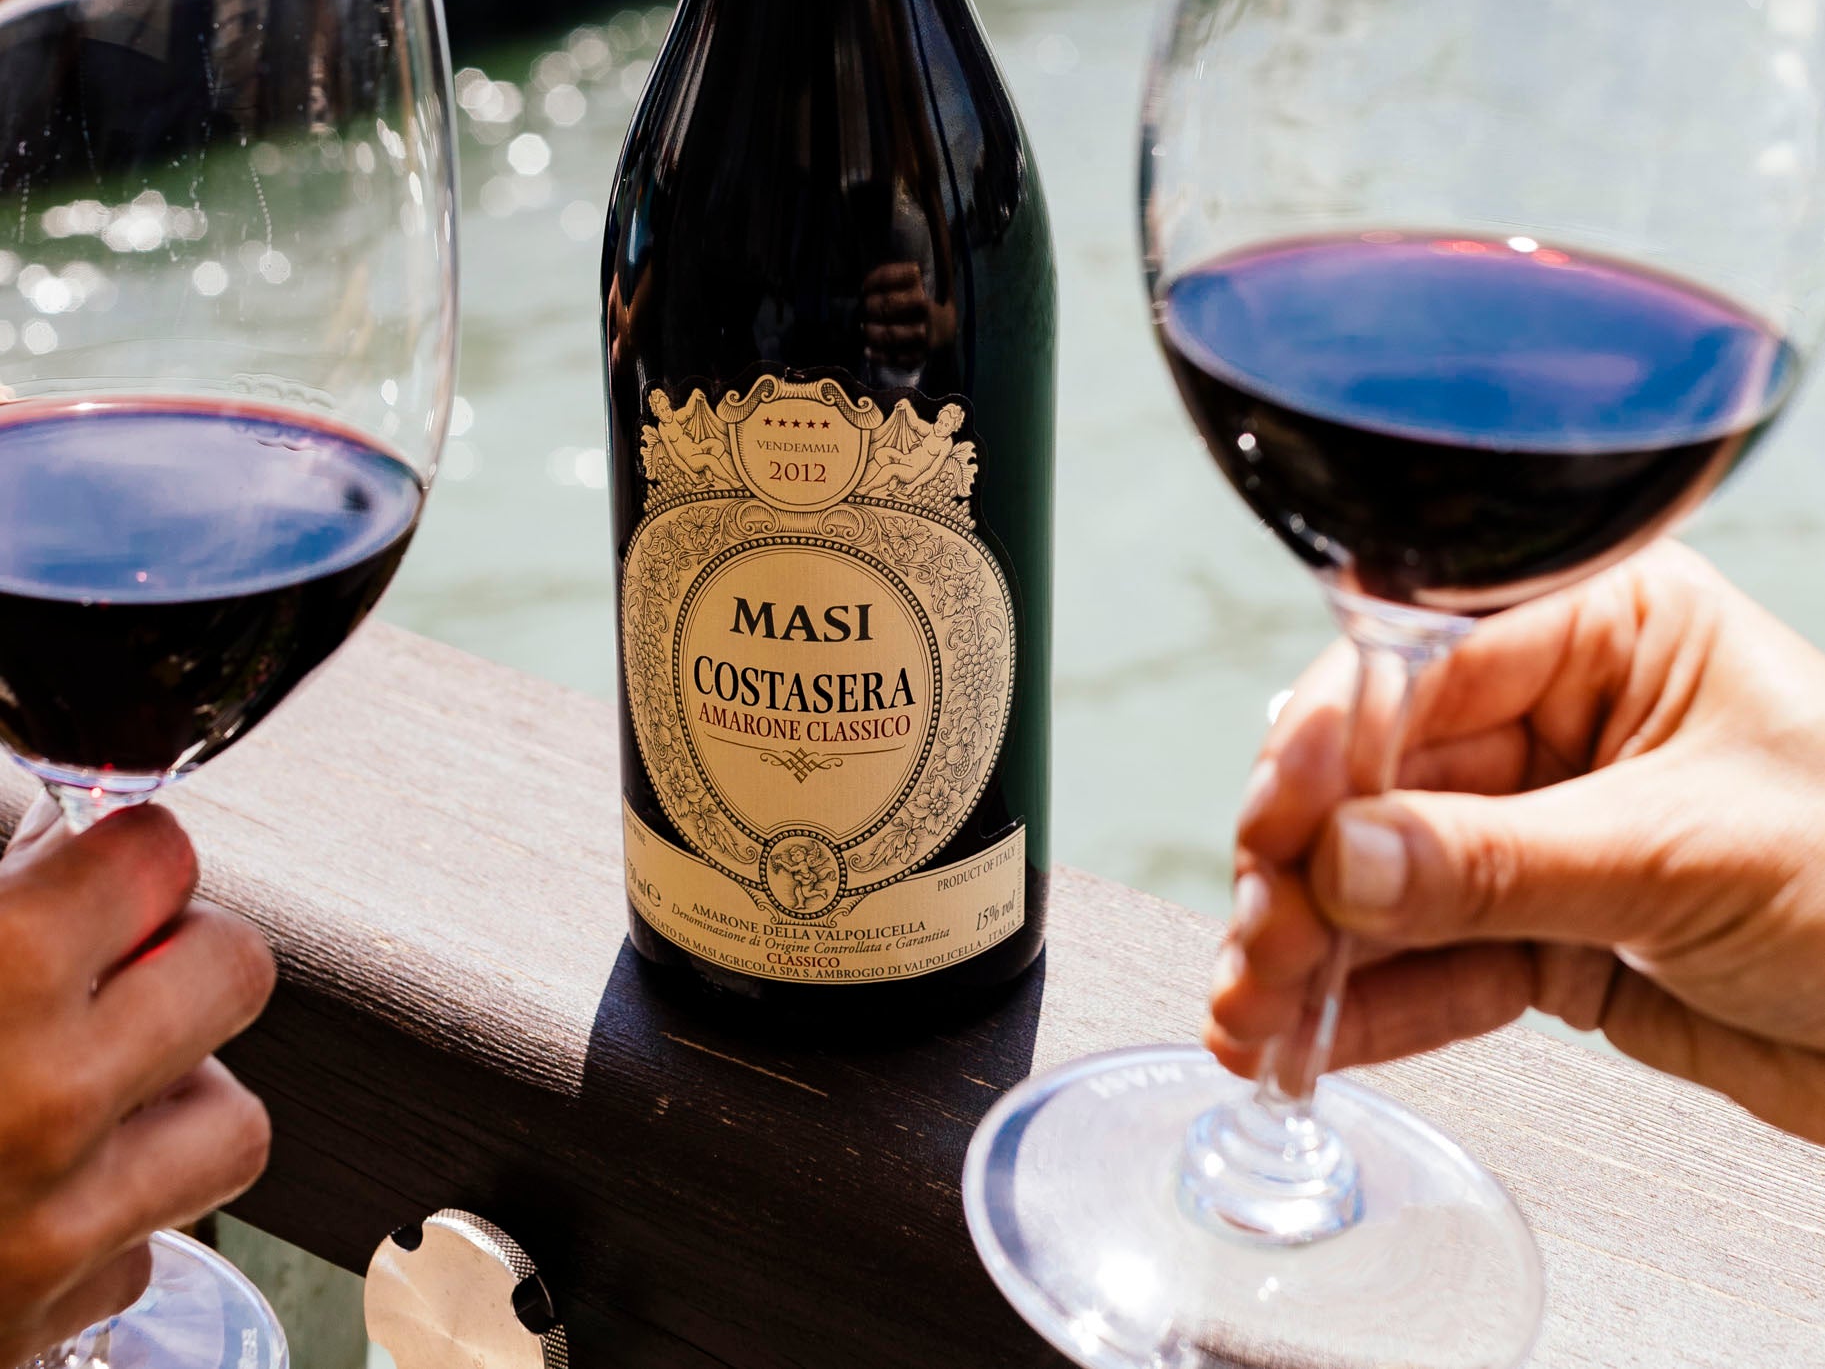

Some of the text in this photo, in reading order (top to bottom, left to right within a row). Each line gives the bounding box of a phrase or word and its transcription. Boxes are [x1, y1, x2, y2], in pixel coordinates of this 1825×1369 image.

[756, 439, 840, 454] VENDEMMIA
[769, 460, 827, 484] 2012
[729, 596, 873, 643] MASI
[694, 655, 916, 714] COSTASERA
[698, 702, 911, 742] AMARONE CLASSICO
[937, 844, 1016, 892] PRODUCT OF ITALY
[672, 903, 950, 954] Denominazione di Origine Controllata e Garantita
[692, 903, 926, 941] AMARONE DELLA VALPOLICELLA
[976, 889, 1016, 931] 15% vol
[678, 933, 691, 946] DA
[692, 939, 717, 959] MASI
[719, 952, 776, 975] AGRICOLA
[779, 966, 800, 977] SPA
[803, 968, 813, 978] S.
[815, 967, 885, 979] AMBROGIO
[888, 965, 901, 976] DI
[904, 942, 982, 973] VALPOLICELLA
[989, 920, 1016, 943] ITALIA
[766, 952, 840, 968] CLASSICO
